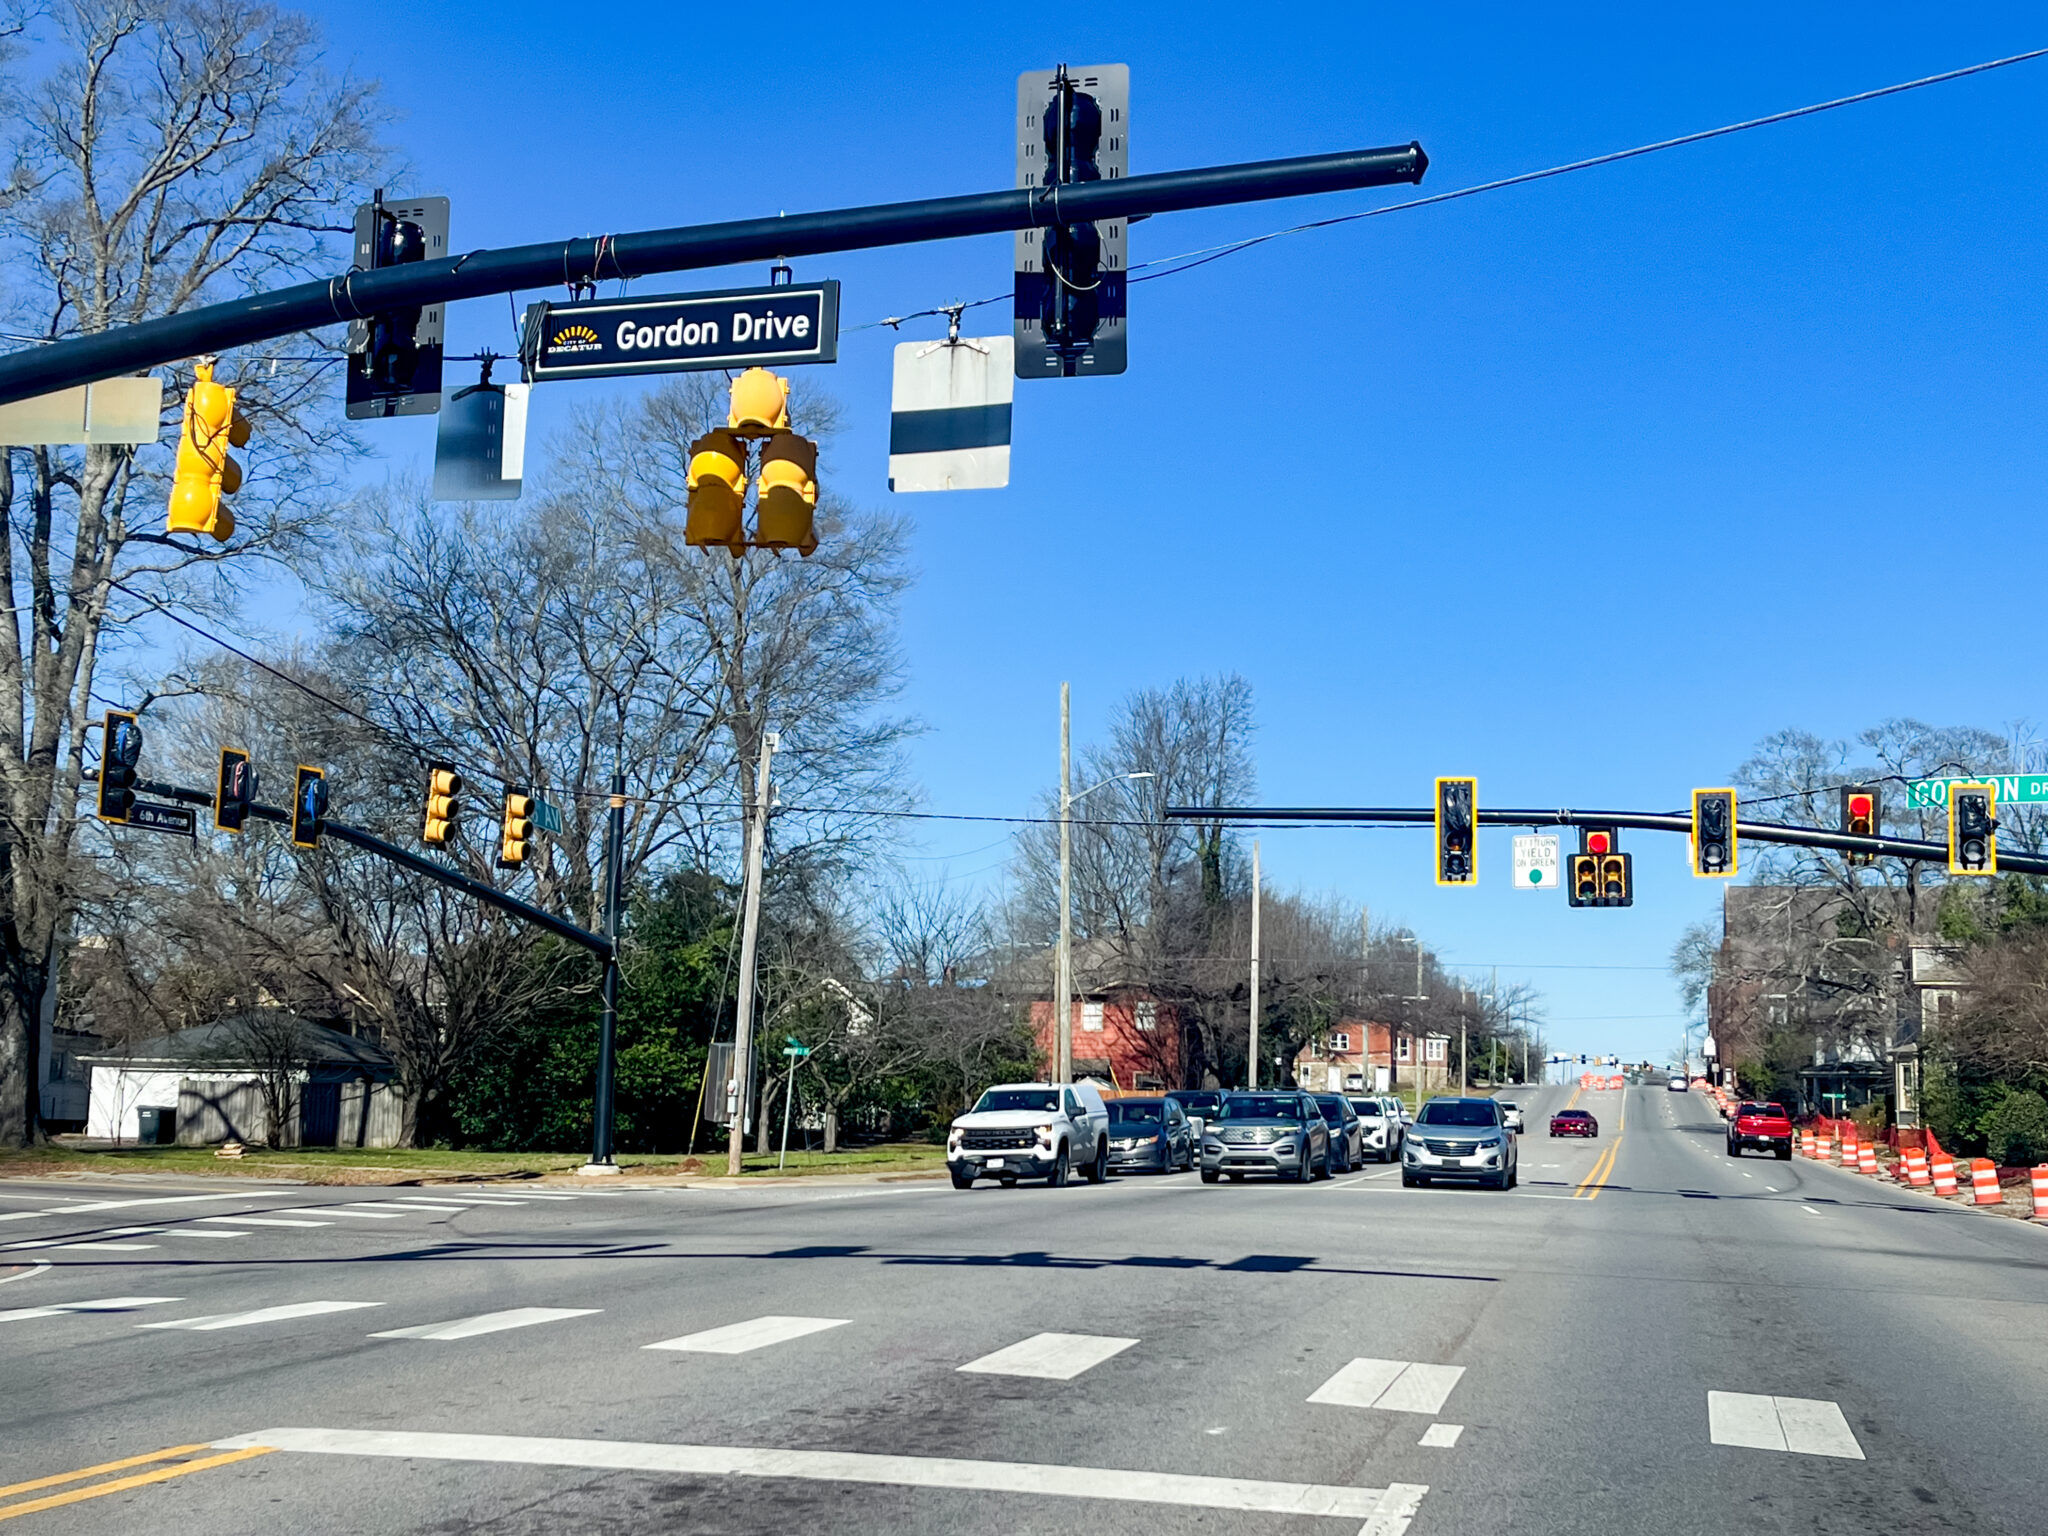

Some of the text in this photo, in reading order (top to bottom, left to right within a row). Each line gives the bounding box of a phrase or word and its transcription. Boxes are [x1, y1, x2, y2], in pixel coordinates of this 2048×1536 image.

[616, 310, 809, 350] Gordon Drive
[547, 343, 603, 354] DECATUR
[1914, 777, 2048, 806] GOON DR
[139, 809, 188, 827] 6th Avenue
[1514, 837, 1556, 848] LEFT TURN
[1521, 847, 1551, 858] YIELD
[1516, 858, 1556, 868] ON GREEN
